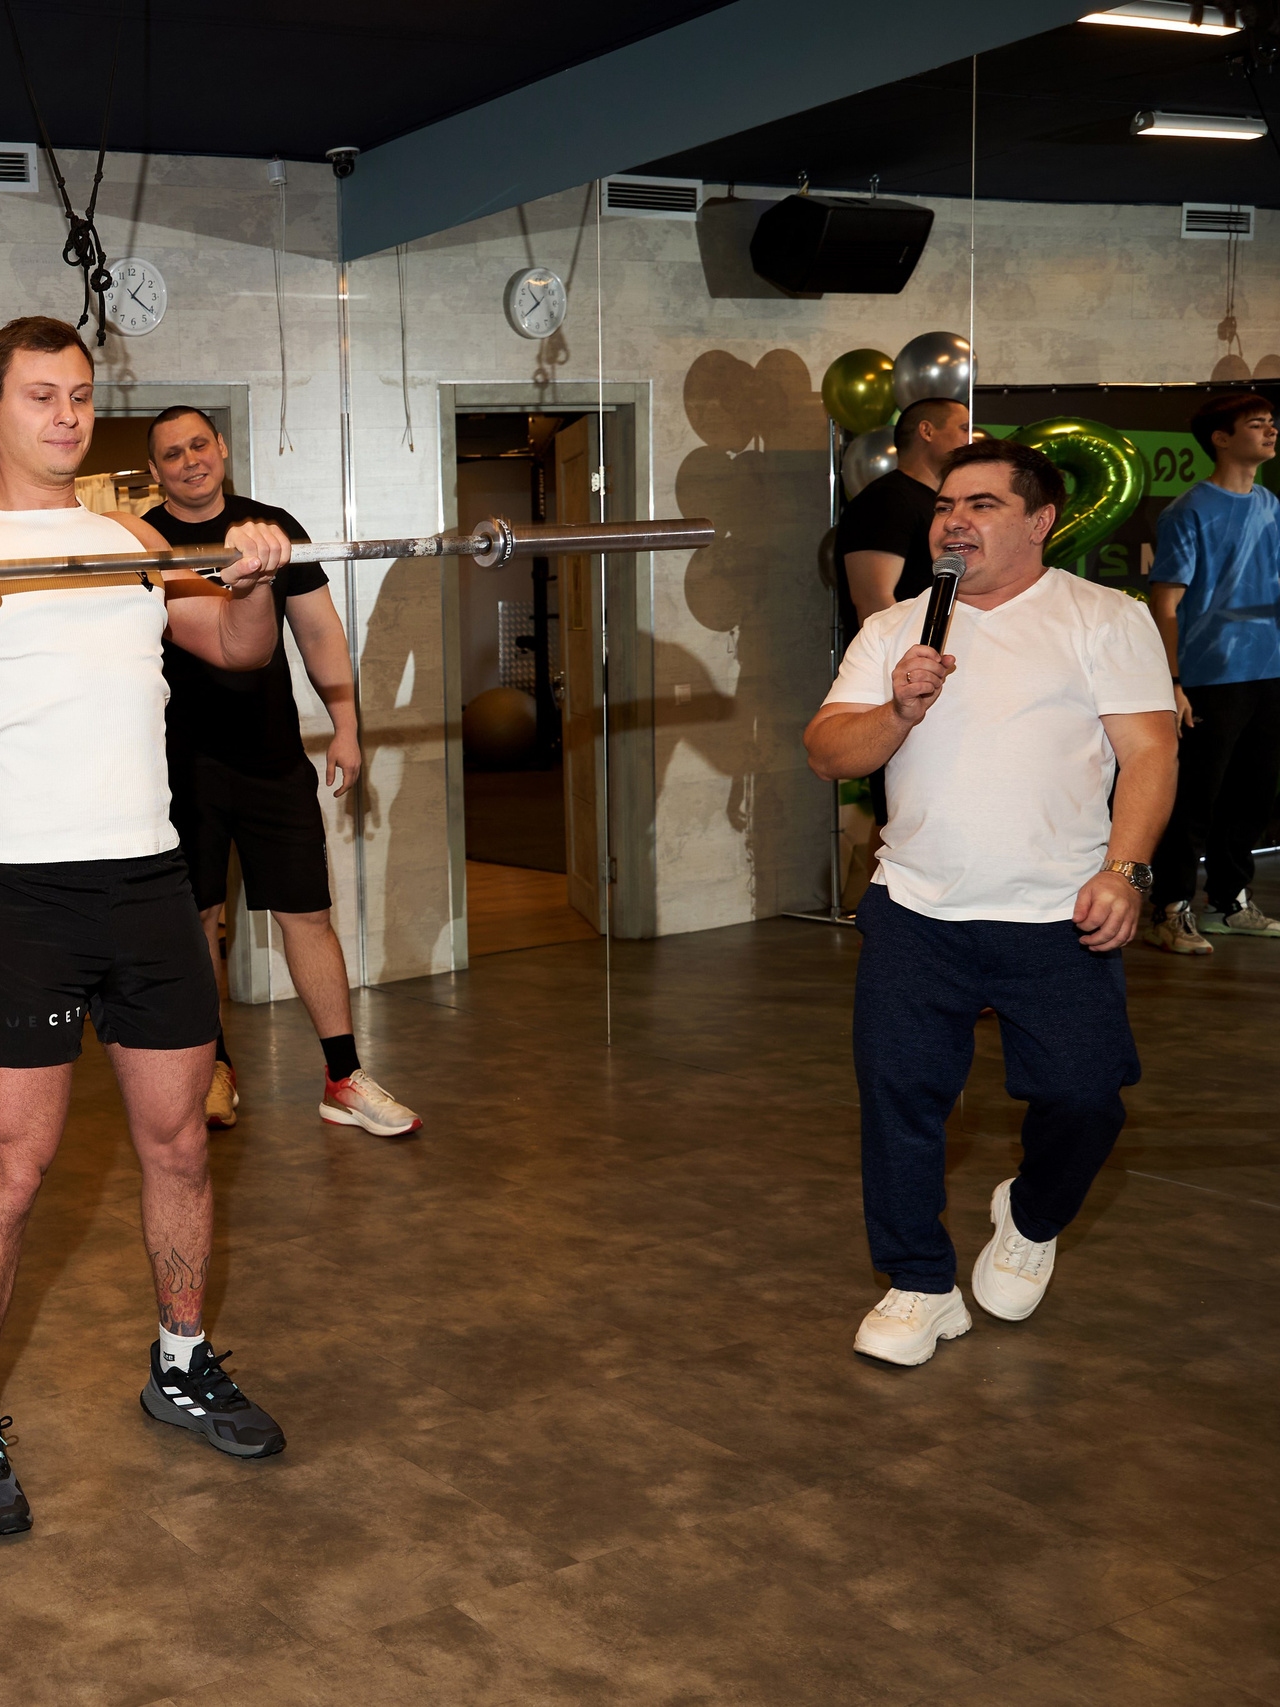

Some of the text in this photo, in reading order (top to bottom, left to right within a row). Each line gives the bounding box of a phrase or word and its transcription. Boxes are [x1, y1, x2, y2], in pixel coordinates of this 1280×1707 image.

[128, 268, 136, 277] 12
[148, 280, 154, 288] 2
[108, 293, 114, 301] 9
[152, 293, 157, 301] 3
[112, 305, 118, 313] 8
[120, 314, 125, 323] 7
[131, 318, 137, 326] 6
[142, 314, 148, 323] 5
